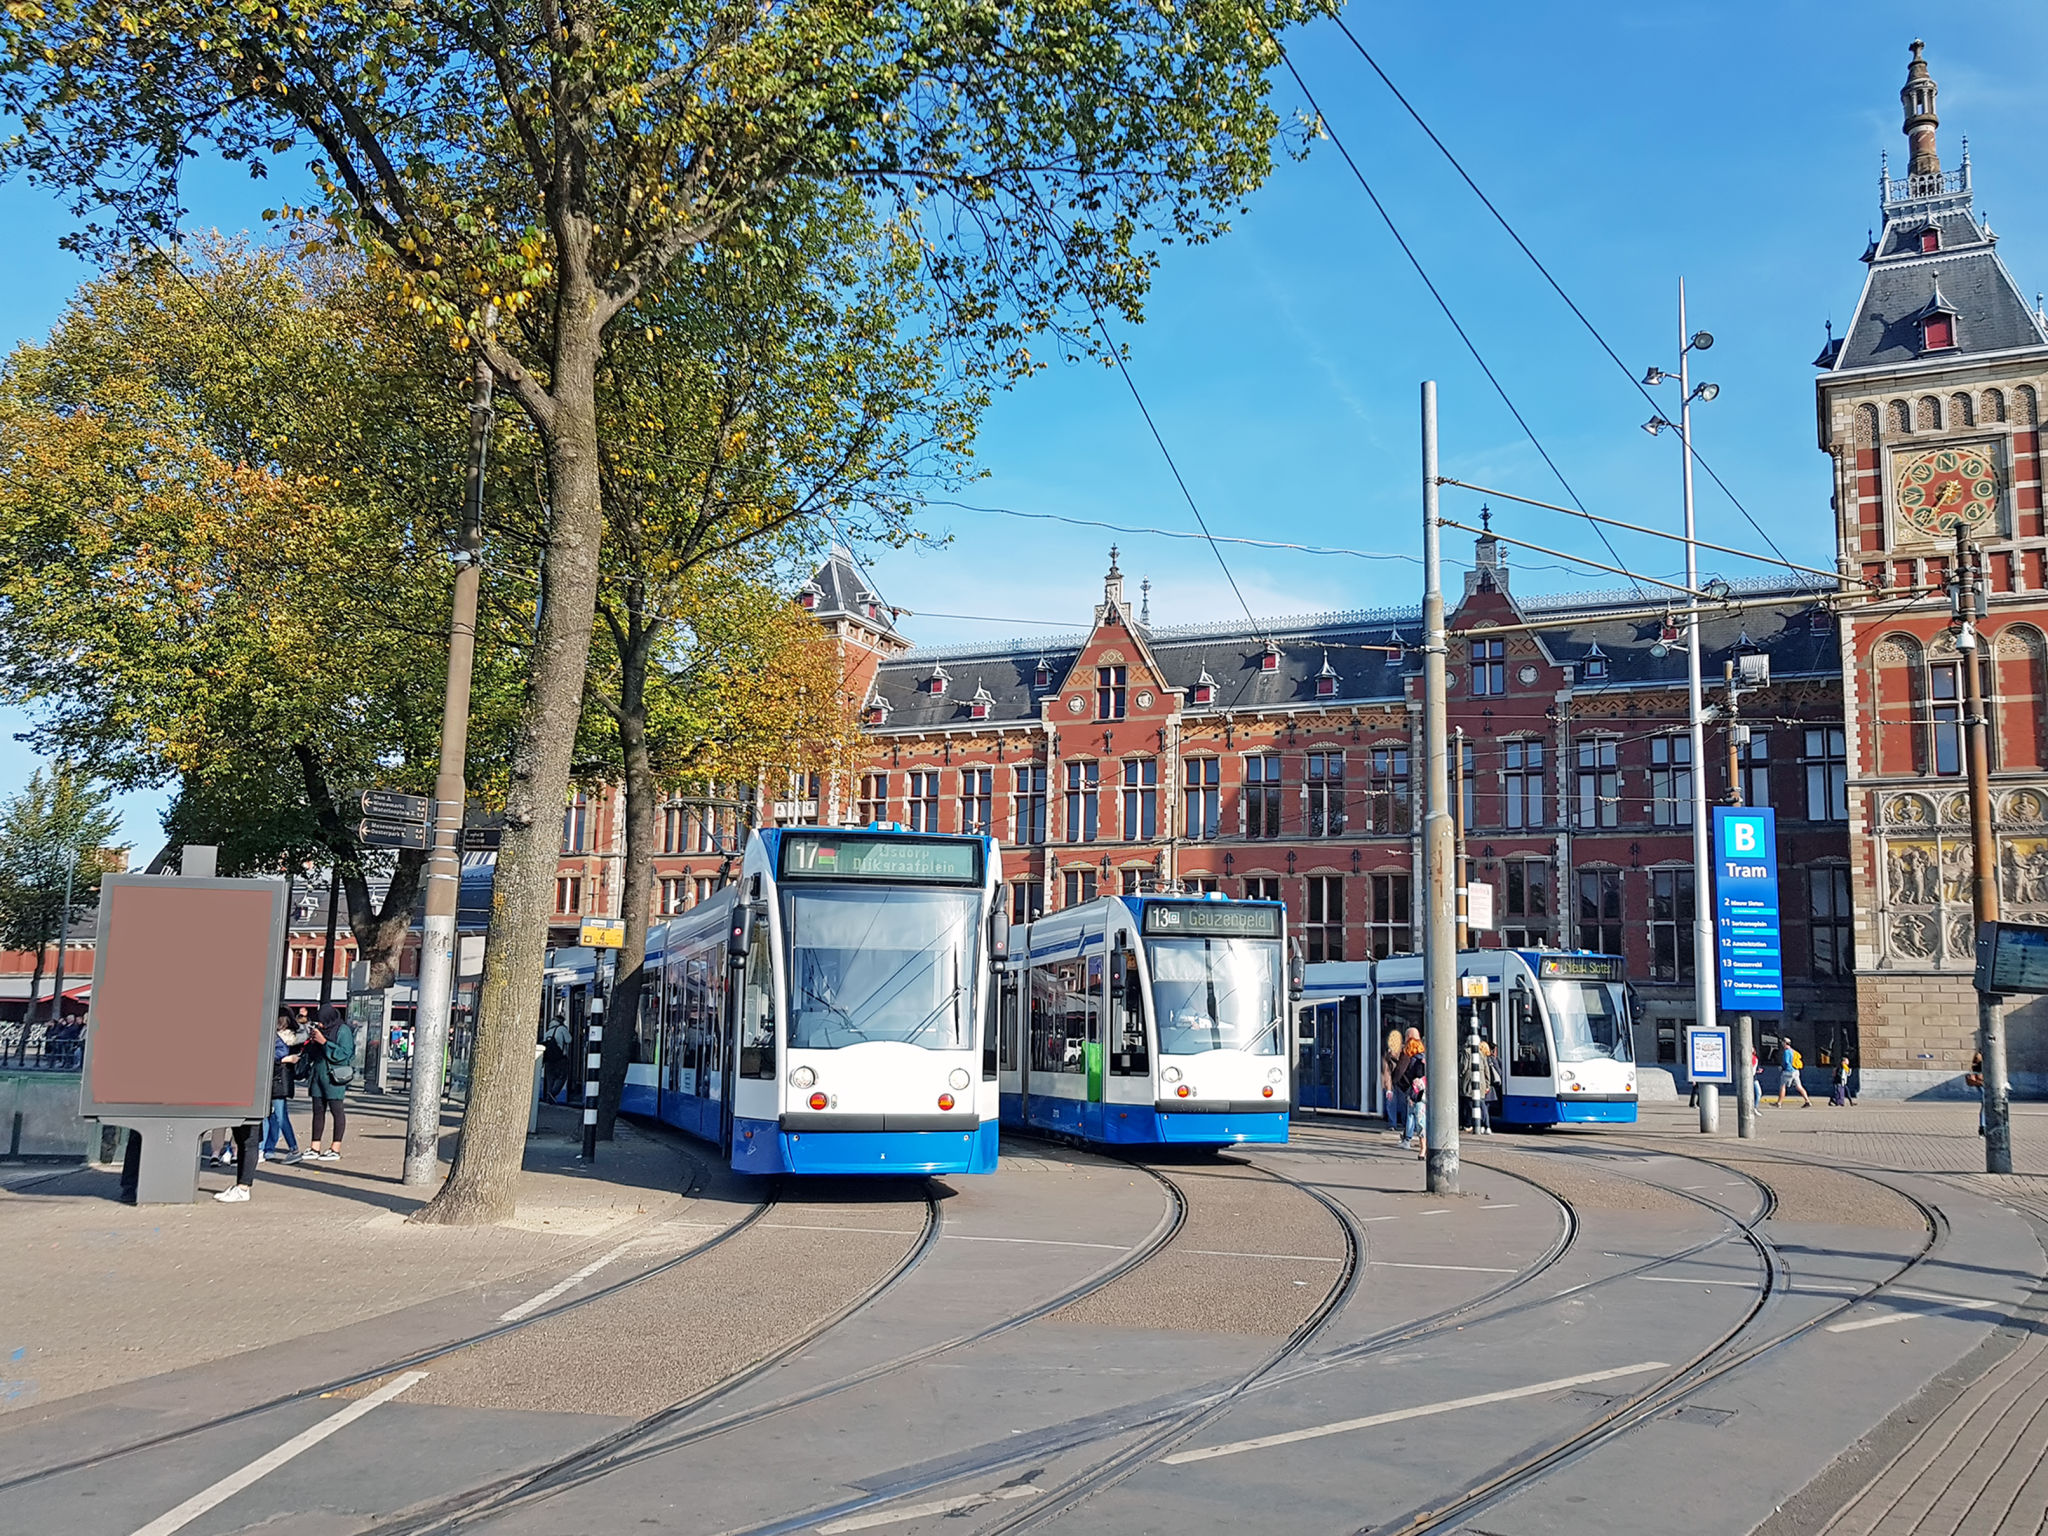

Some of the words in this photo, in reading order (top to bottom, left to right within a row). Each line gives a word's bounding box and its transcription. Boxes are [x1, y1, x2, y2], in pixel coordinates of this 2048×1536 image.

[1735, 823, 1756, 851] B
[795, 841, 820, 869] 17
[1725, 862, 1767, 878] Tram
[1724, 897, 1730, 906] 2
[1153, 907, 1169, 927] 13
[1721, 918, 1730, 927] 11
[1721, 938, 1731, 947] 12
[1545, 960, 1552, 975] 2
[1722, 958, 1732, 967] 13
[1723, 979, 1733, 988] 17
